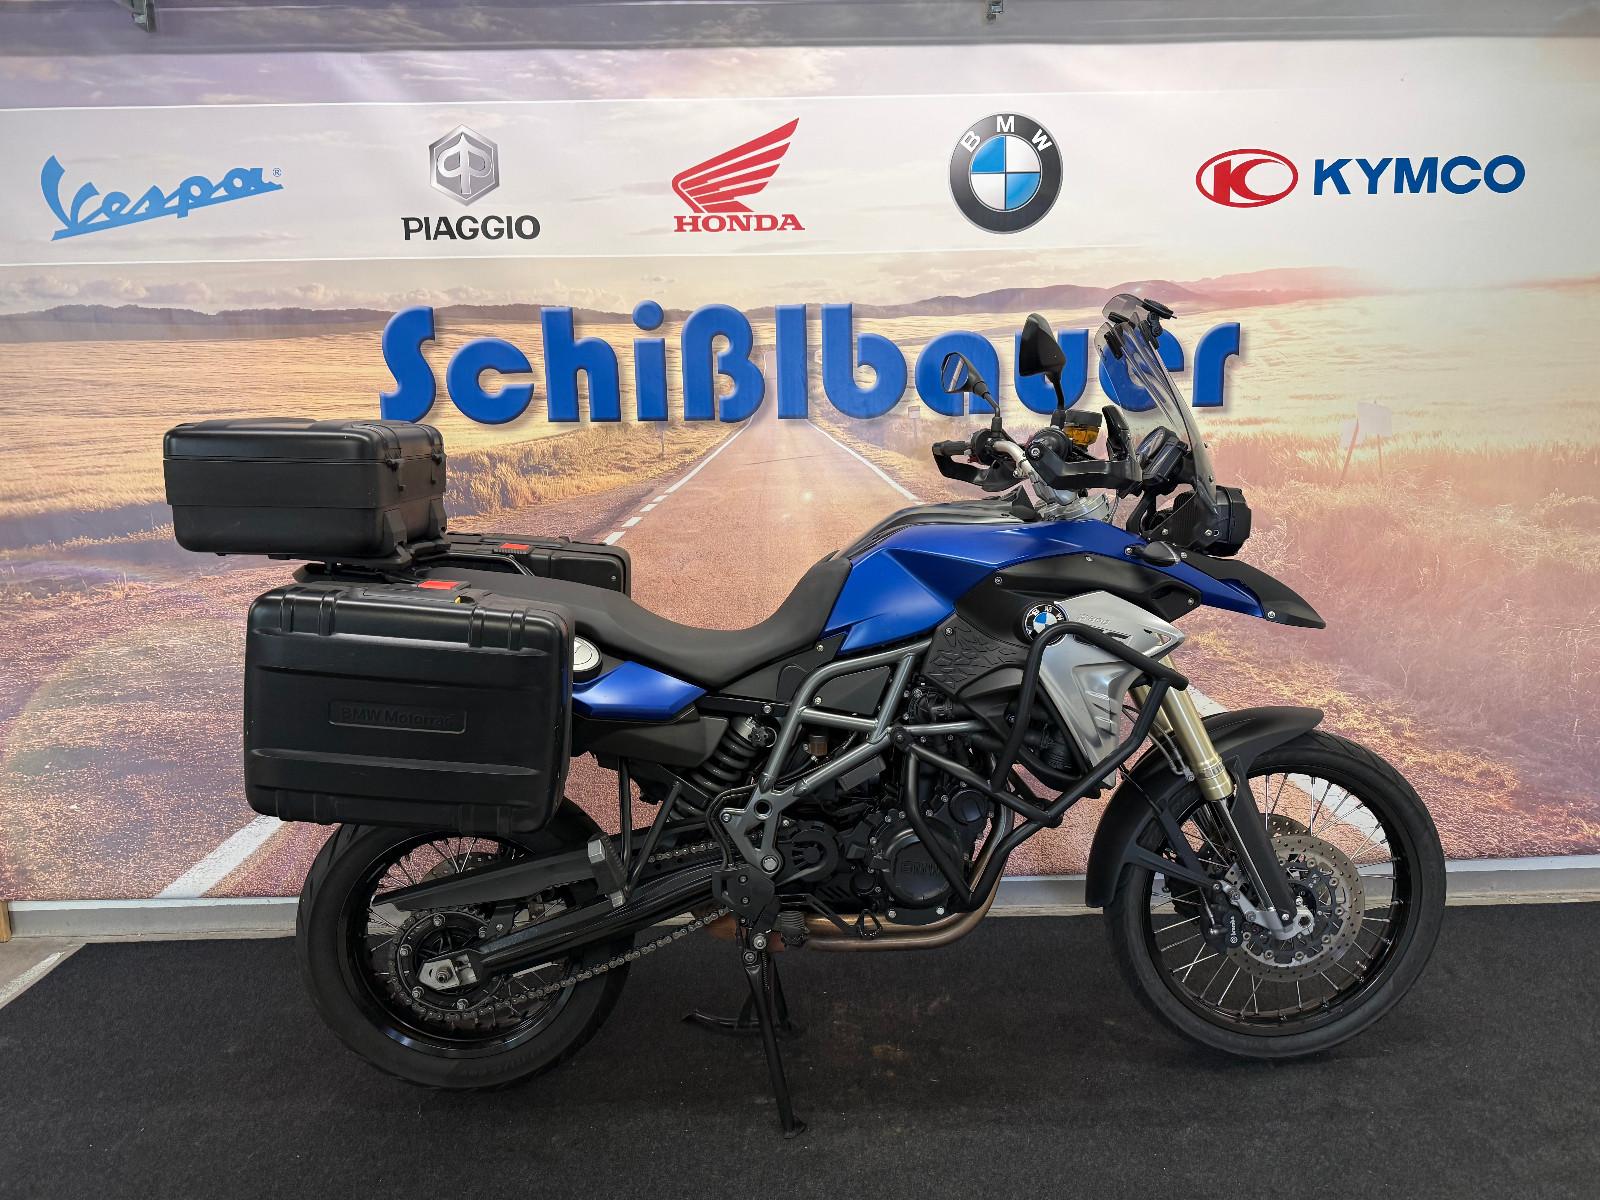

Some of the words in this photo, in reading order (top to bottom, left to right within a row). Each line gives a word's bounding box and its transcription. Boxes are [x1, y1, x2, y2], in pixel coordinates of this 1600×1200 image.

[960, 115, 1053, 153] BMW
[1313, 154, 1526, 196] KYMCO
[401, 214, 541, 241] PIAGGIO
[673, 213, 806, 233] HONDA
[379, 300, 1241, 425] Schißlbauer
